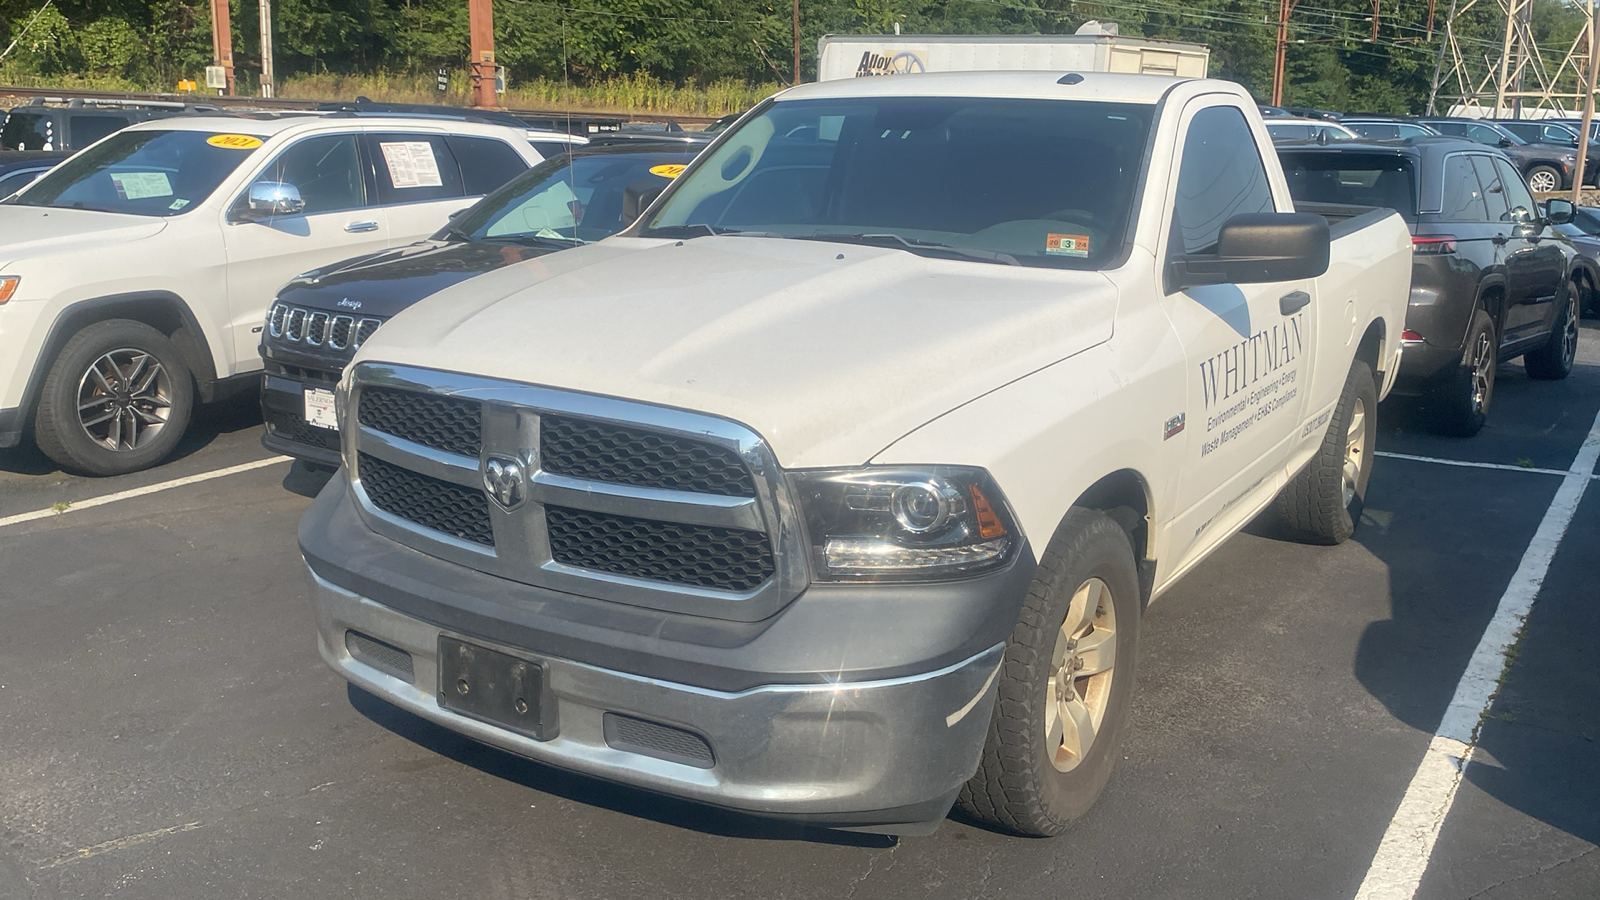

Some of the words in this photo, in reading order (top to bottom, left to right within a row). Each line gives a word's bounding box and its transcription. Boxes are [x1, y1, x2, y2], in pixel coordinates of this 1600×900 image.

[857, 51, 892, 71] Alloy
[213, 136, 256, 147] 2021
[656, 166, 686, 176] 20
[1065, 240, 1072, 248] 3
[337, 297, 362, 310] Jeep
[1200, 313, 1303, 411] WHITMAN
[1207, 395, 1247, 432] Environmental
[1250, 379, 1279, 405] Engineering
[1282, 369, 1297, 385] Energy
[1202, 437, 1220, 457] Waste
[1220, 413, 1254, 445] Management
[1257, 401, 1272, 421] EH&S
[1272, 388, 1297, 411] Compliance
